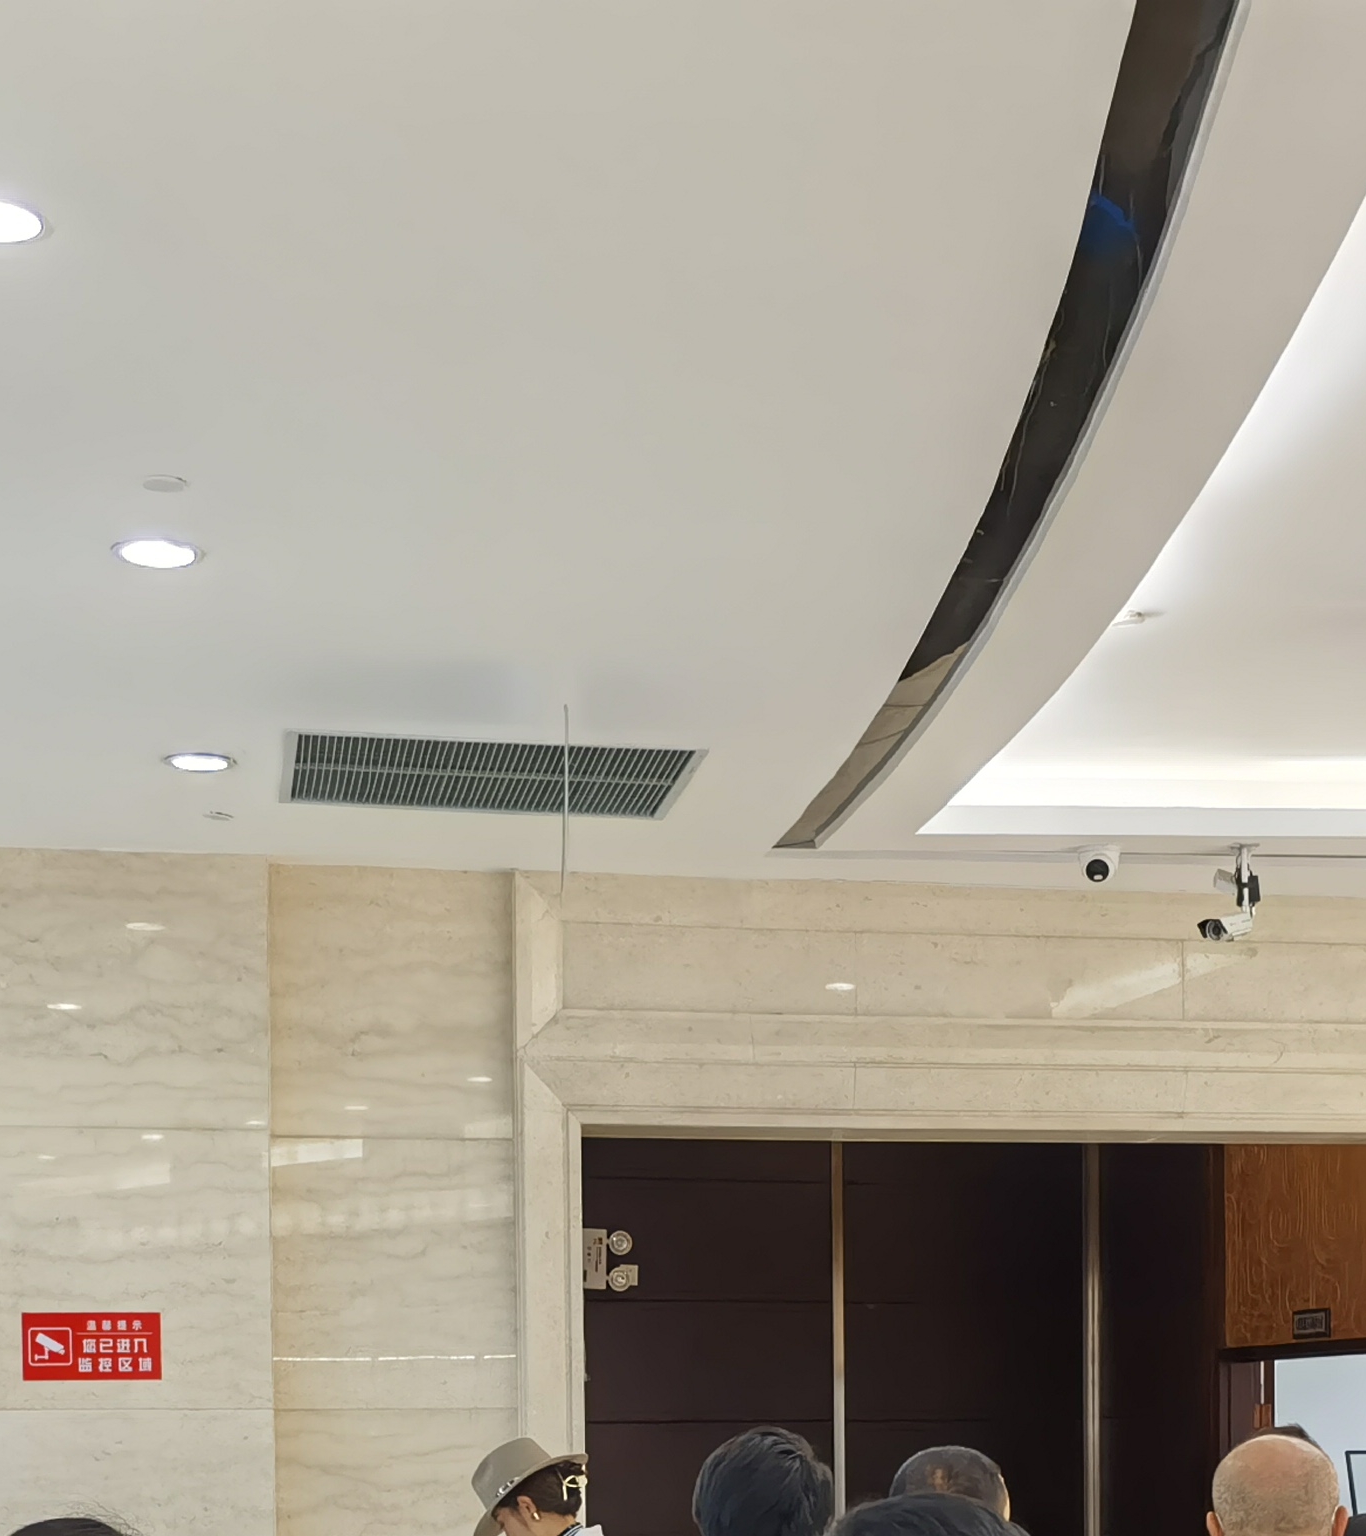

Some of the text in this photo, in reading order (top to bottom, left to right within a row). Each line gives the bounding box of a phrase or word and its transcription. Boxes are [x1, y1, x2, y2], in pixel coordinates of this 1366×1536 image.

[82, 1338, 148, 1353] 您已进入
[78, 1357, 153, 1372] 监控区域
